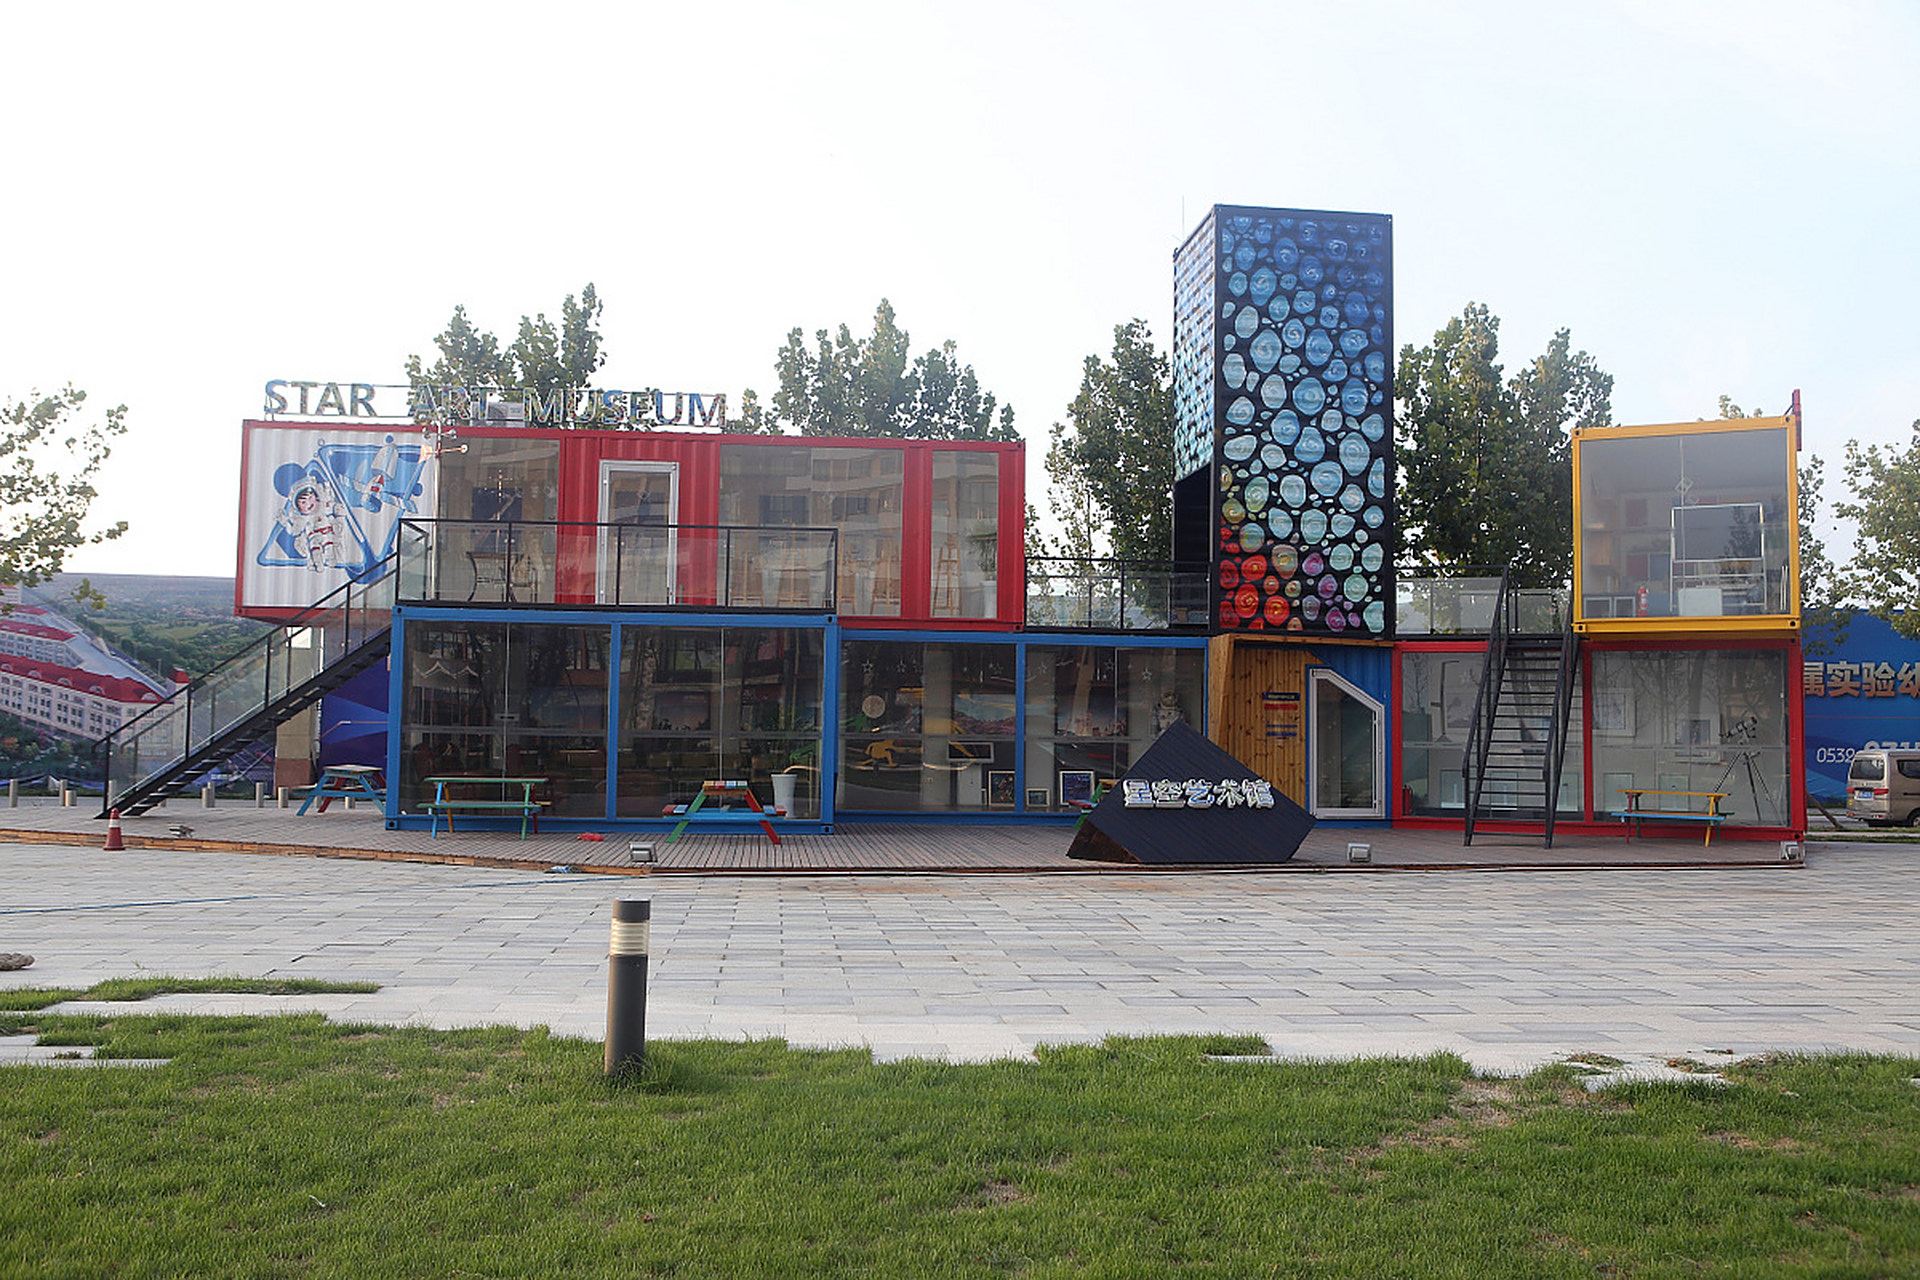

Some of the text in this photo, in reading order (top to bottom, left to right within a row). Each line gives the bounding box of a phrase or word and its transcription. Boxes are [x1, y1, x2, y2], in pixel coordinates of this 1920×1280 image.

[264, 379, 728, 428] STAR ART MUSEUM
[1123, 778, 1275, 809] 星空艺术馆
